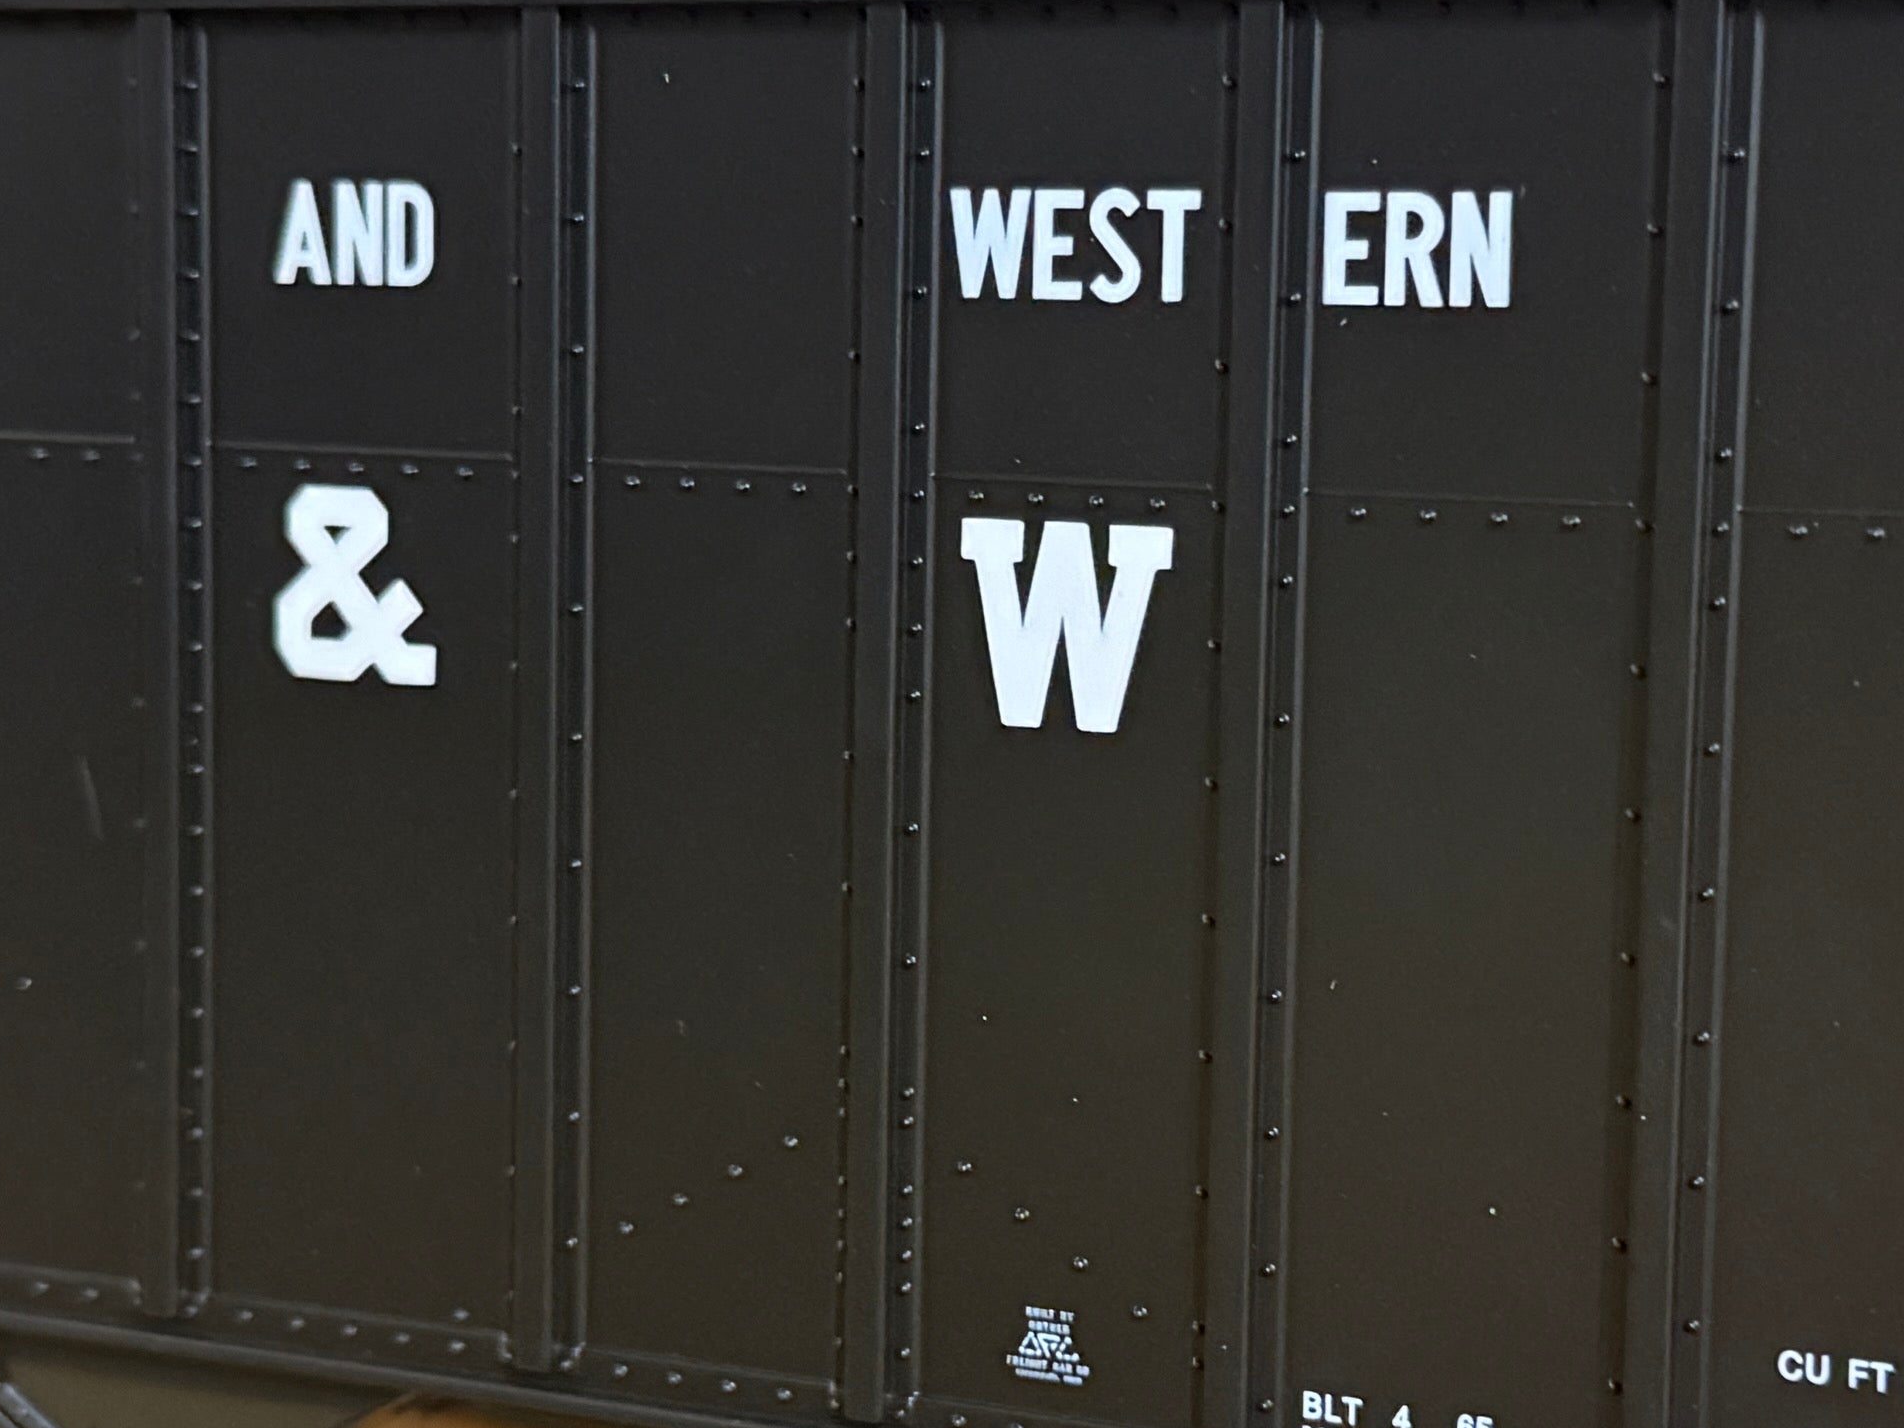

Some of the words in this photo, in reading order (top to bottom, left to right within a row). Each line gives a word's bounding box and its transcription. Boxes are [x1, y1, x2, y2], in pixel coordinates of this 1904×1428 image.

[273, 178, 435, 287] AND
[949, 186, 1203, 304] WEST
[1322, 188, 1514, 309] ERN
[273, 483, 438, 686] &
[960, 516, 1175, 734] W
[1302, 1389, 1364, 1427] BLT
[1777, 1349, 1832, 1386] CU
[1847, 1357, 1896, 1394] FT
